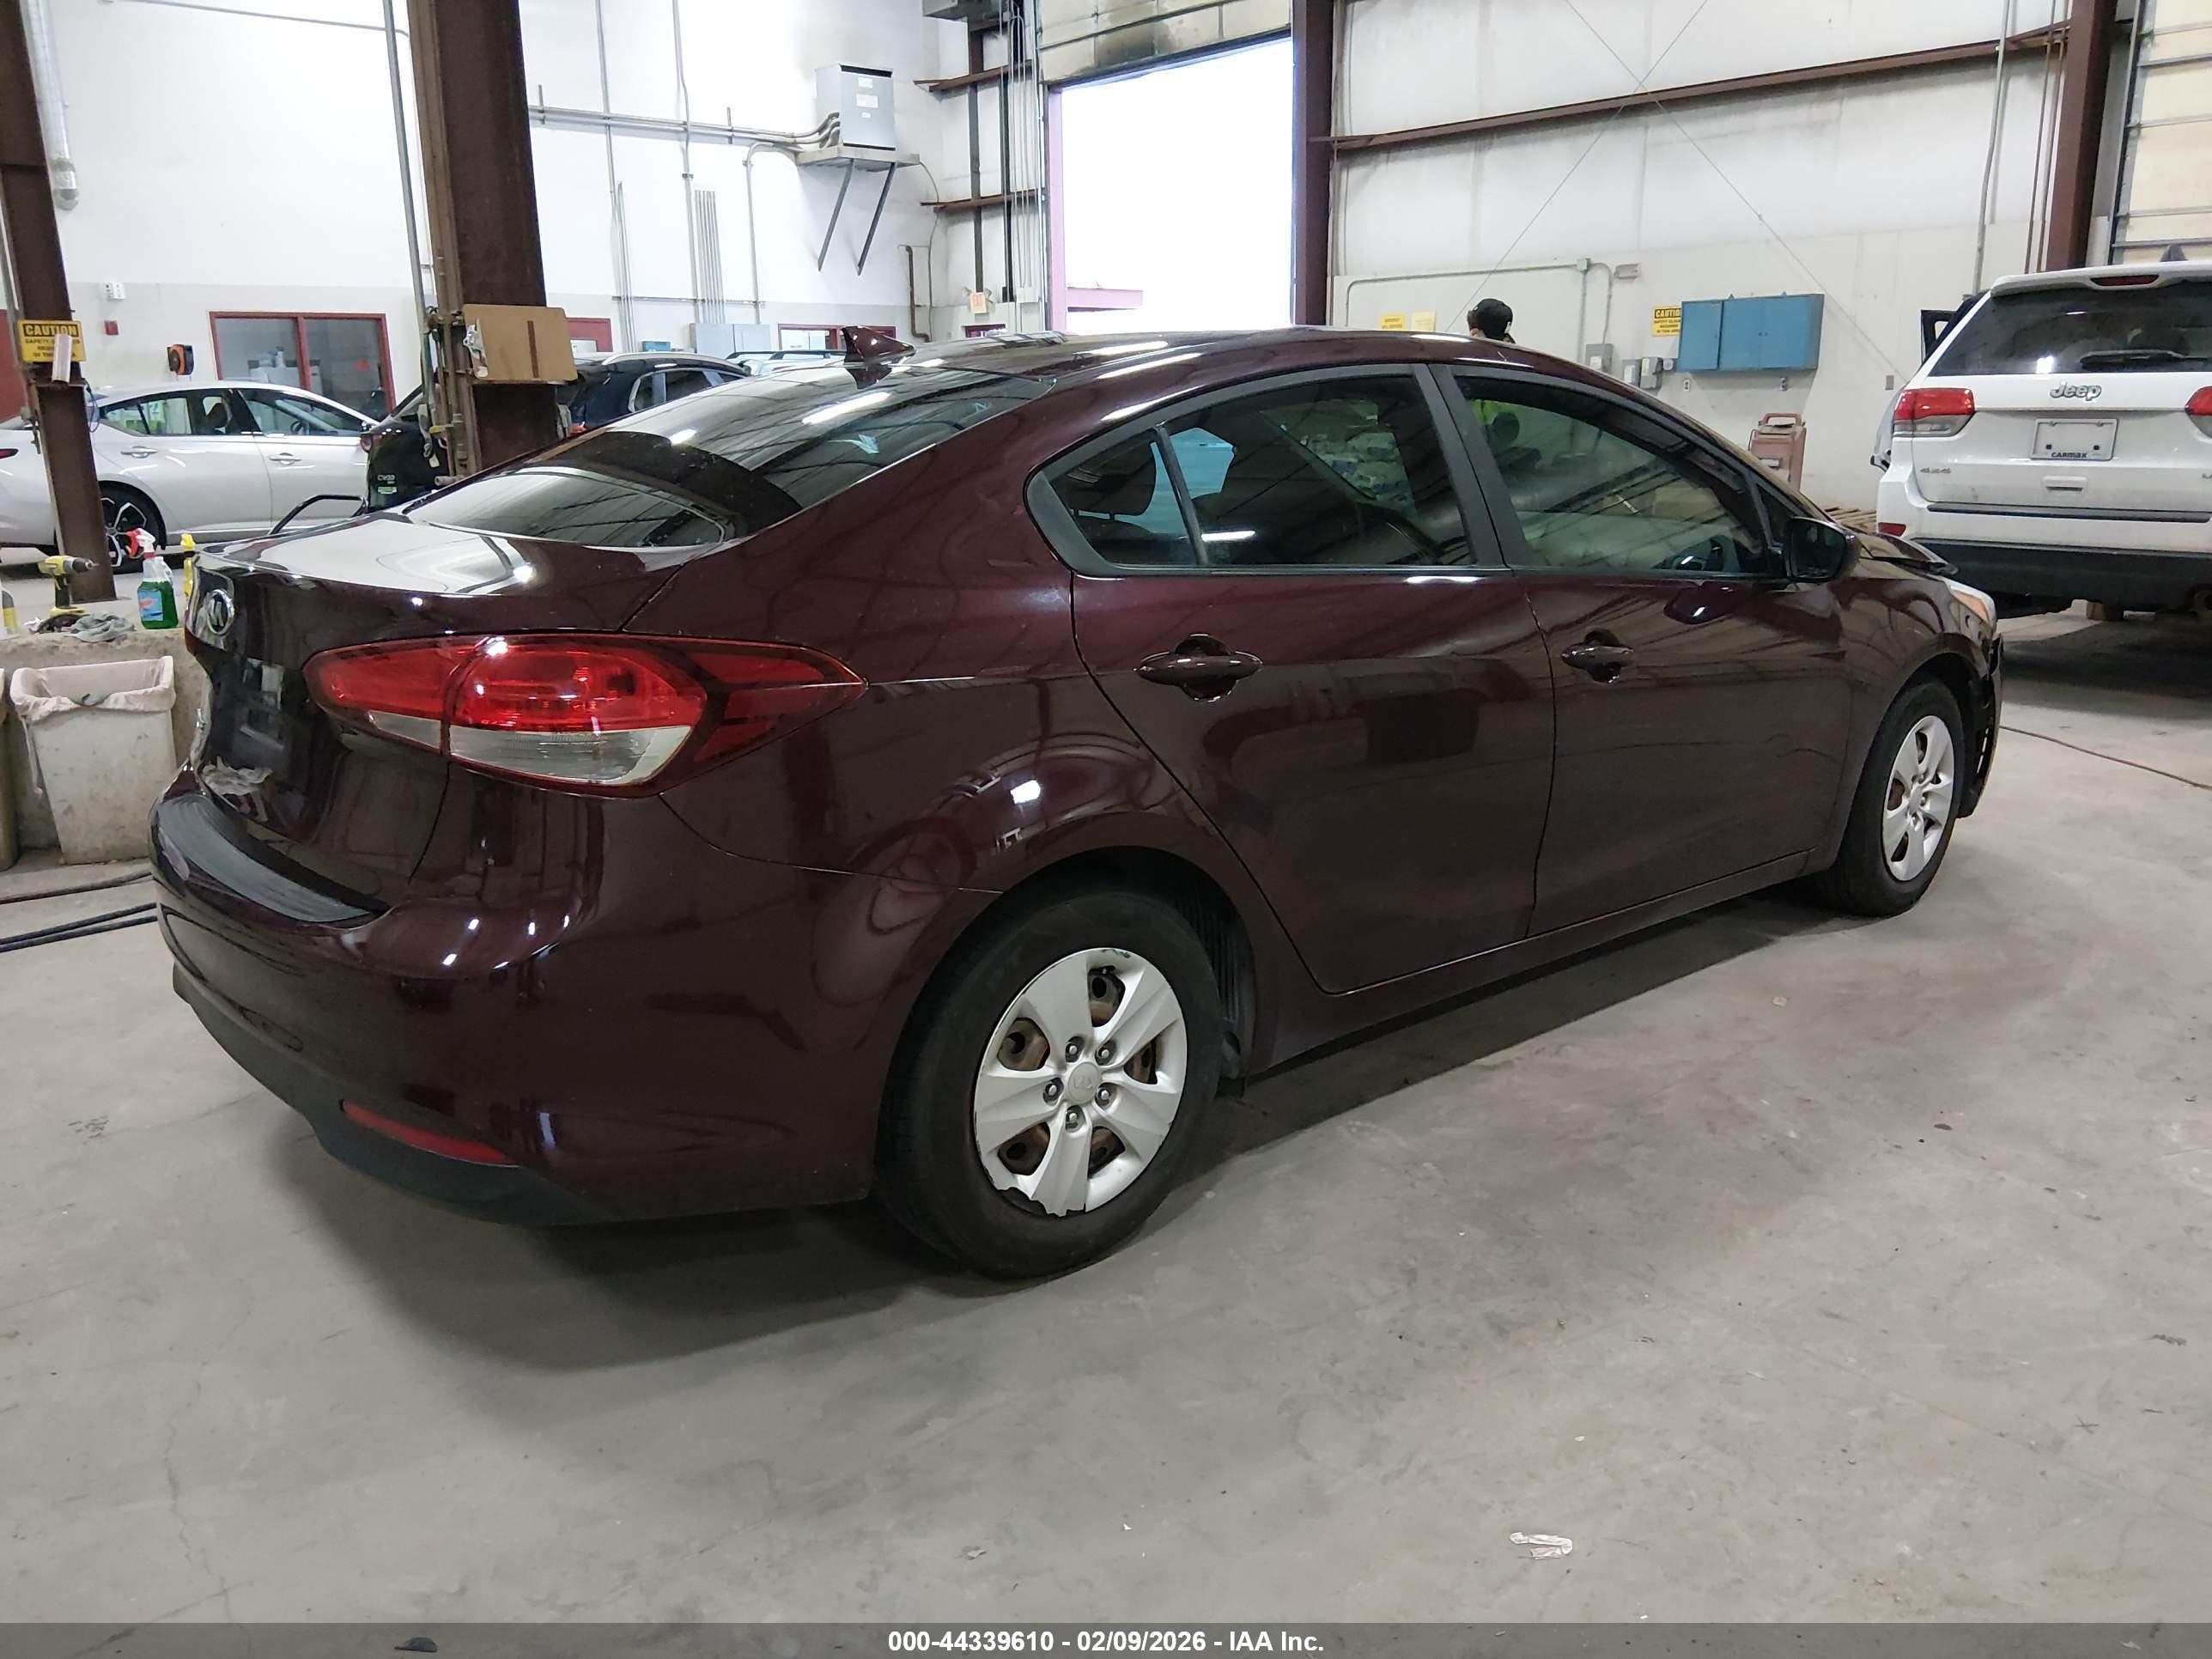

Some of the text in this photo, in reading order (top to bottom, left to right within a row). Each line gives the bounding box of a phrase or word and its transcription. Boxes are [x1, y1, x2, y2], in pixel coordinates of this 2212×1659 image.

[1656, 308, 1681, 318] CAUTIO
[24, 324, 79, 337] CAUTION
[2050, 380, 2102, 401] Jeep
